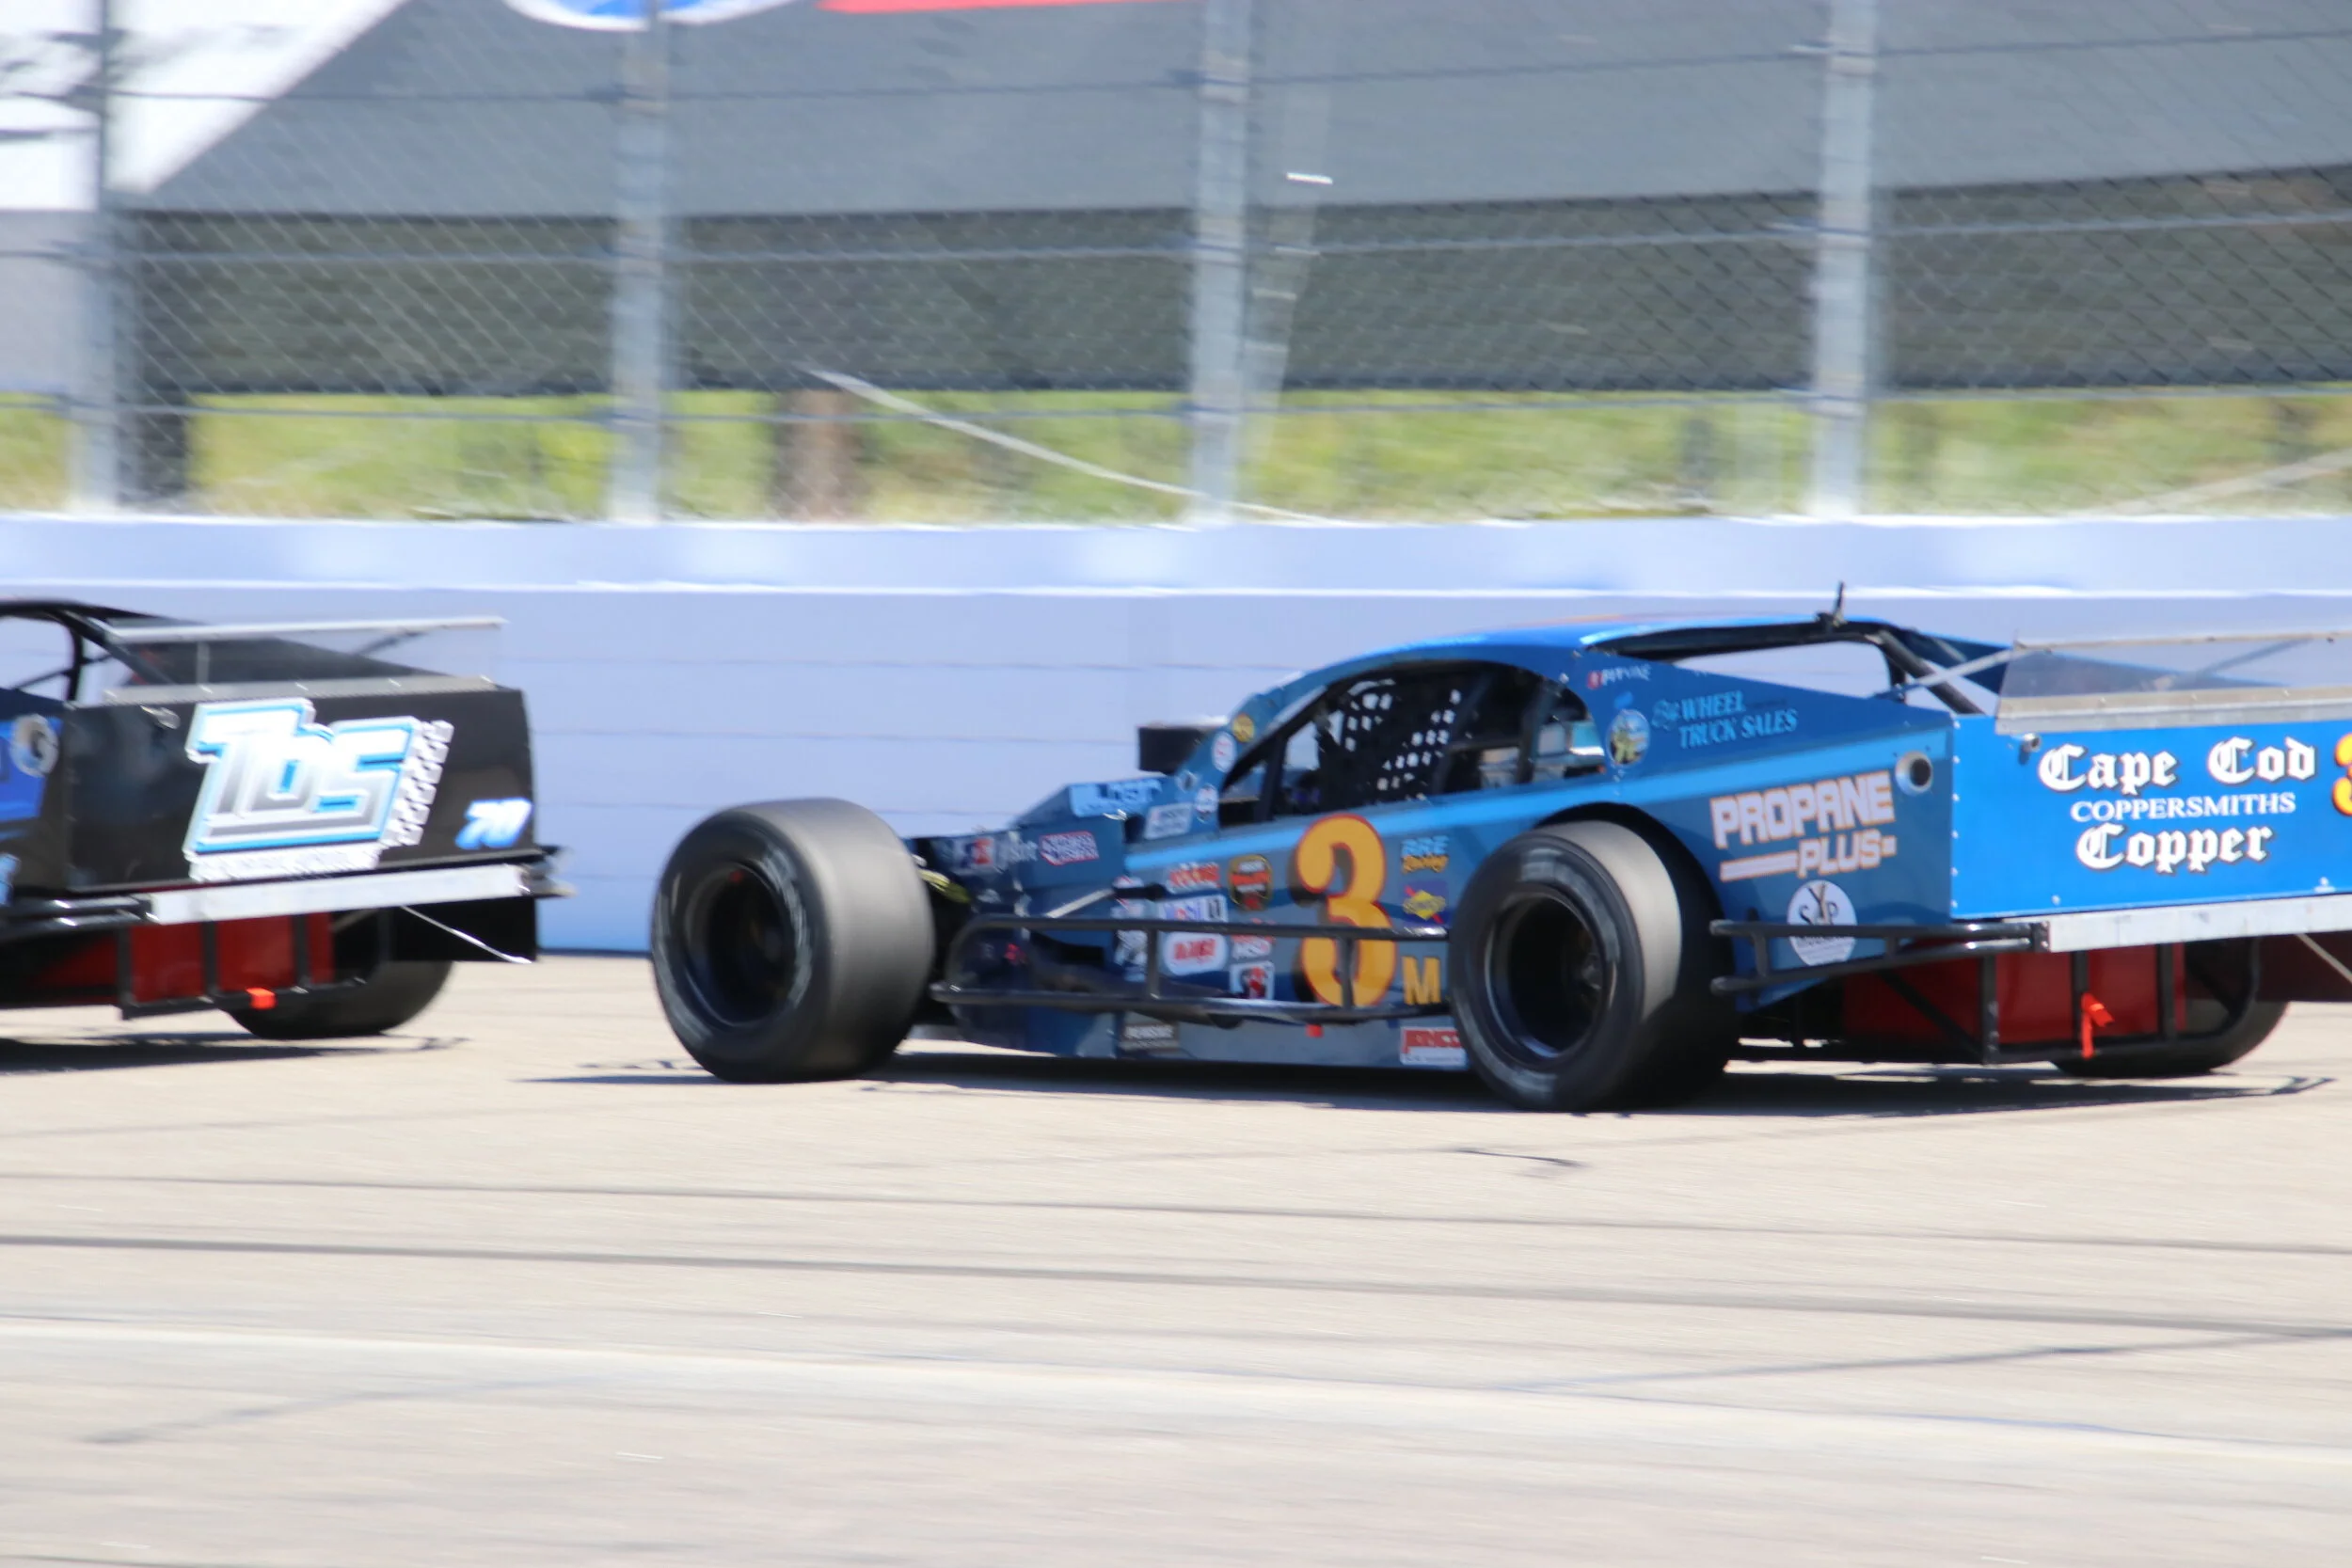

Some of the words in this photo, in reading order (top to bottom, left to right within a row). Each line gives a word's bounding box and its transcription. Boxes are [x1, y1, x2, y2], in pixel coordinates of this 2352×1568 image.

[1741, 708, 1798, 739] SALES
[2039, 743, 2179, 796] Cape
[2207, 736, 2316, 784] Cod
[1709, 769, 1895, 849] PROPANE
[2071, 792, 2296, 822] COPPERSMITHS
[1797, 828, 1882, 879] PLUS
[2075, 822, 2275, 875] Copper
[1295, 813, 1398, 1008] 3
[1402, 956, 1441, 1006] M
